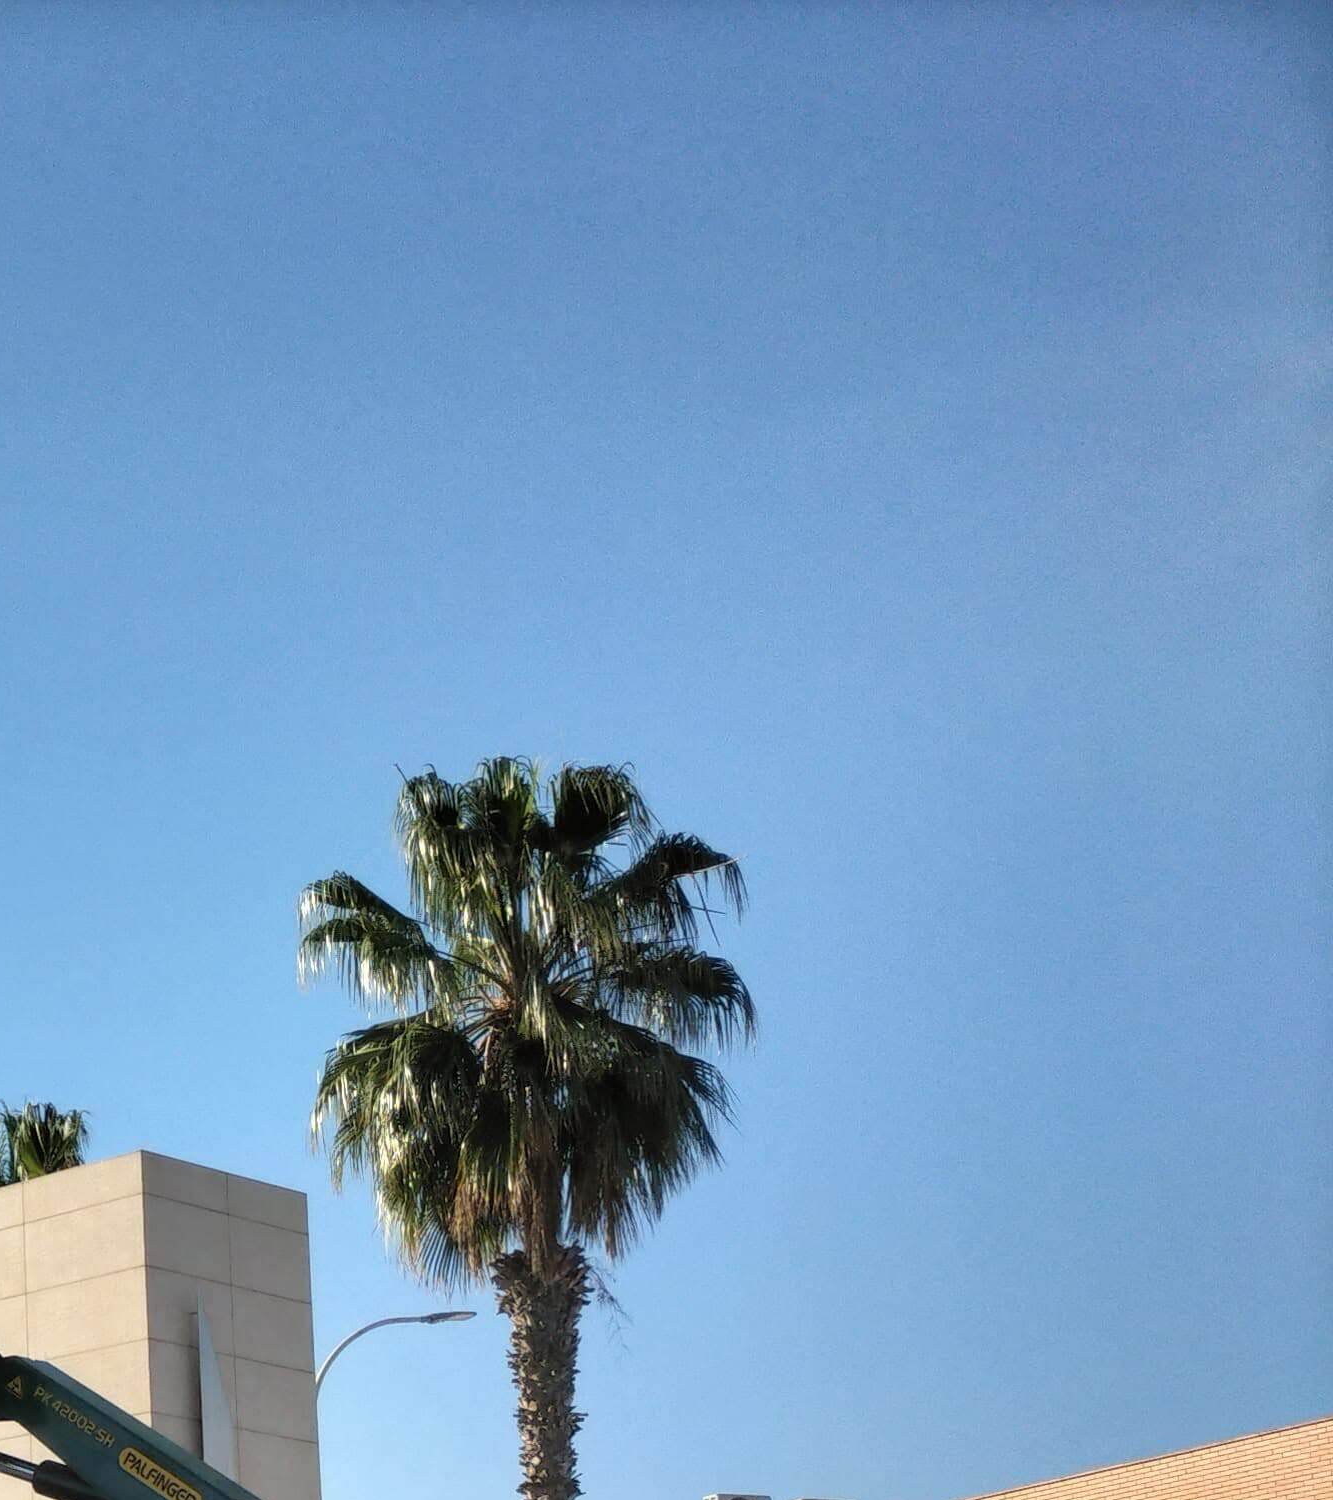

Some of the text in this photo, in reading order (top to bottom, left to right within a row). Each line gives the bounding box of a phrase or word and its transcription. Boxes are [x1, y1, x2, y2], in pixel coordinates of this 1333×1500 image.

[34, 1386, 116, 1448] PK 42002 SH
